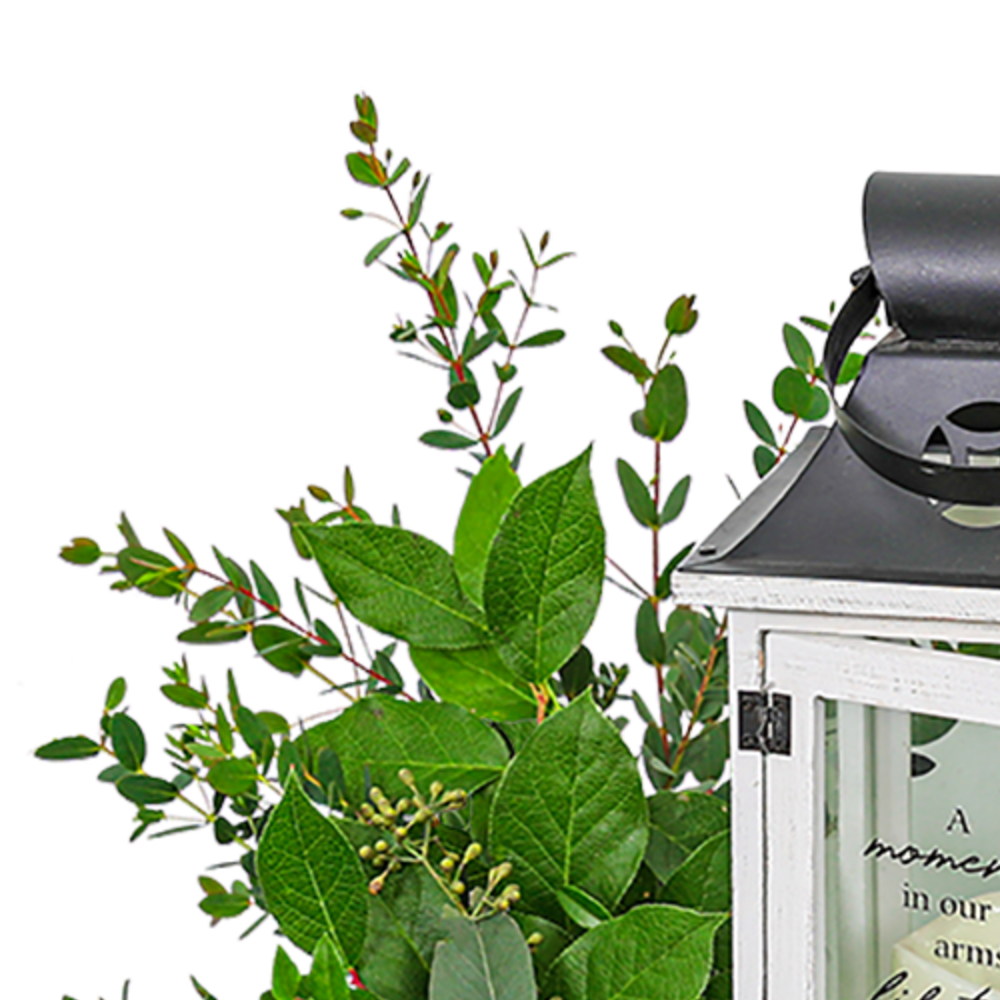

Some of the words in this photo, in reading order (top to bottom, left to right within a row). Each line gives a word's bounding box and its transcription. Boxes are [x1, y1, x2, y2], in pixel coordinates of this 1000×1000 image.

[946, 808, 971, 835] A
[902, 882, 930, 912] in
[940, 893, 993, 923] our
